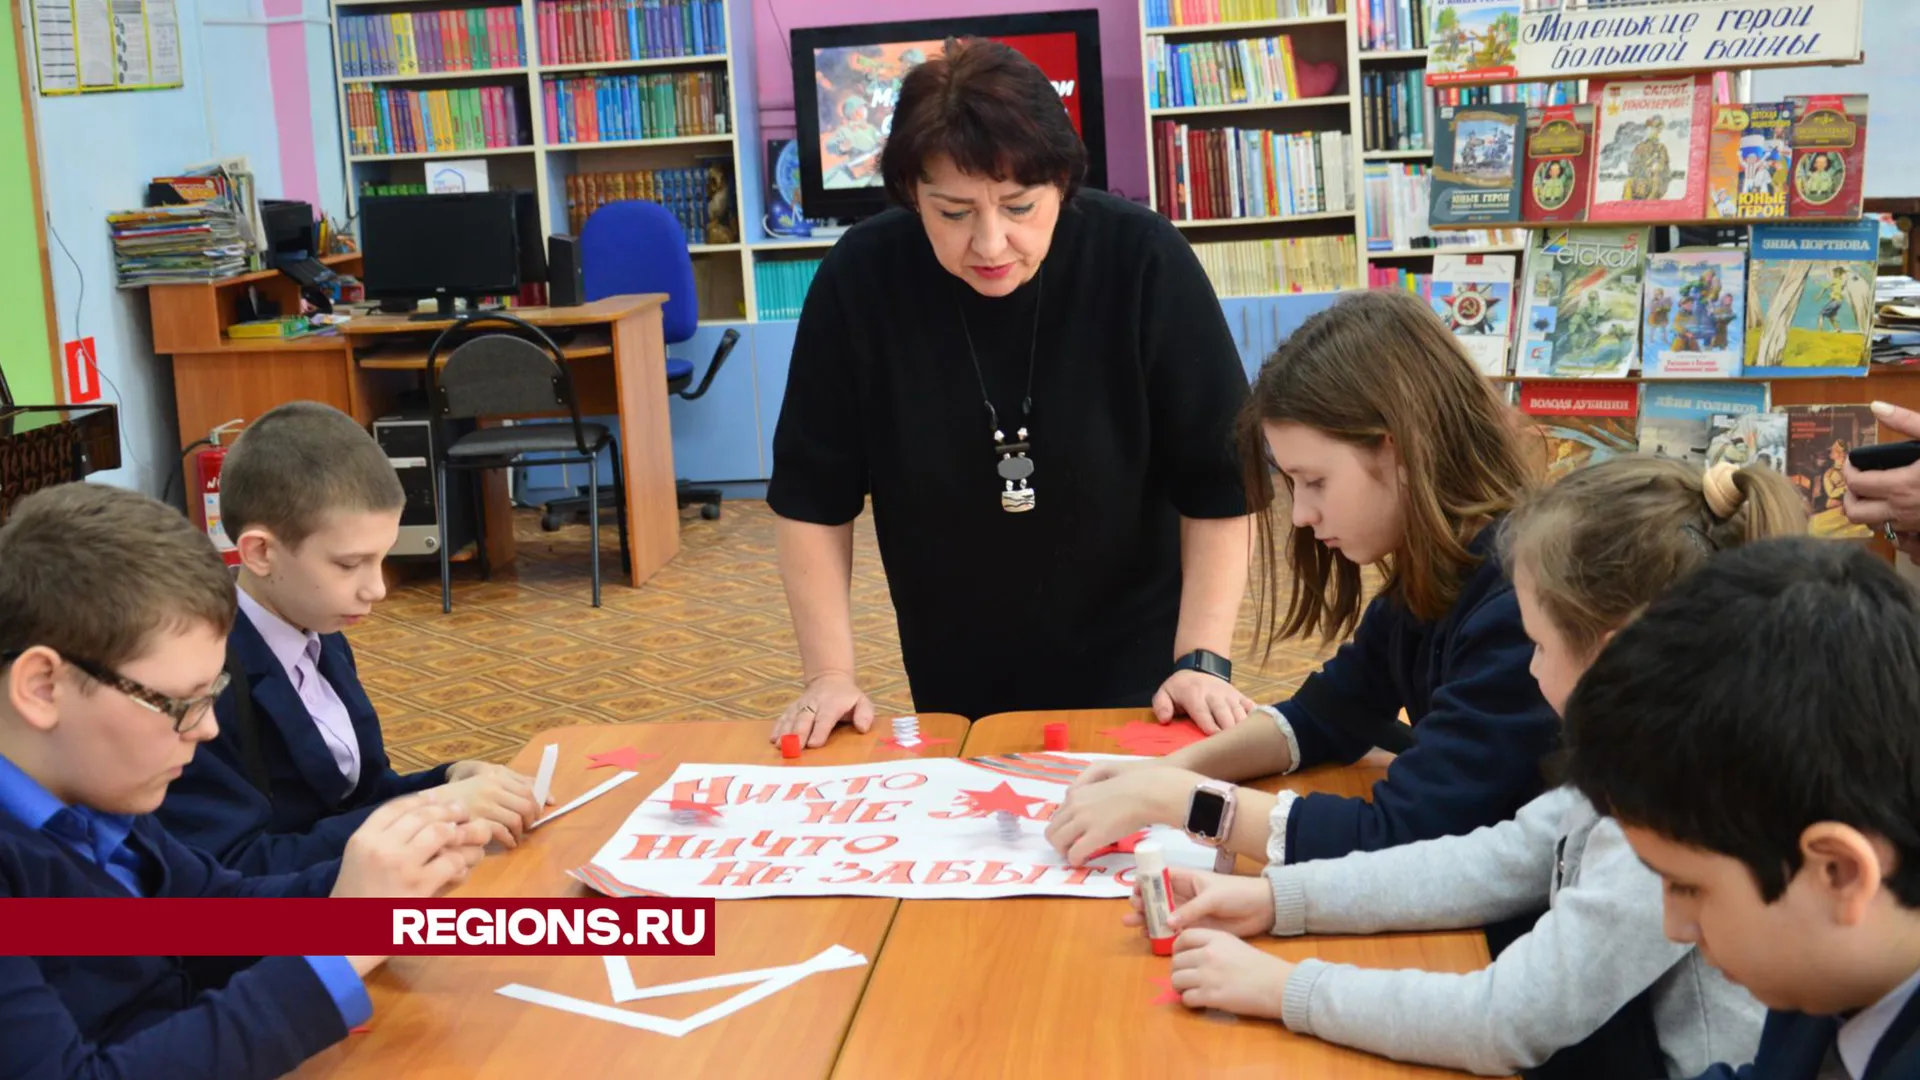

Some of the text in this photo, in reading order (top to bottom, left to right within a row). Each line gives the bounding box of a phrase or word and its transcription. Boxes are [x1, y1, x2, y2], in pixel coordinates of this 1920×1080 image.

[1522, 5, 1814, 44] Маленькие герои
[1551, 32, 1822, 70] большой войны
[1739, 192, 1786, 204] ЮНЫЕ
[1738, 205, 1785, 217] ГЕРОИ
[1762, 238, 1871, 251] ЗИНА ПОРТНОВА
[1530, 398, 1573, 410] ВОЛОДЯ
[799, 797, 912, 824] НЕ
[696, 861, 805, 887] НЕ
